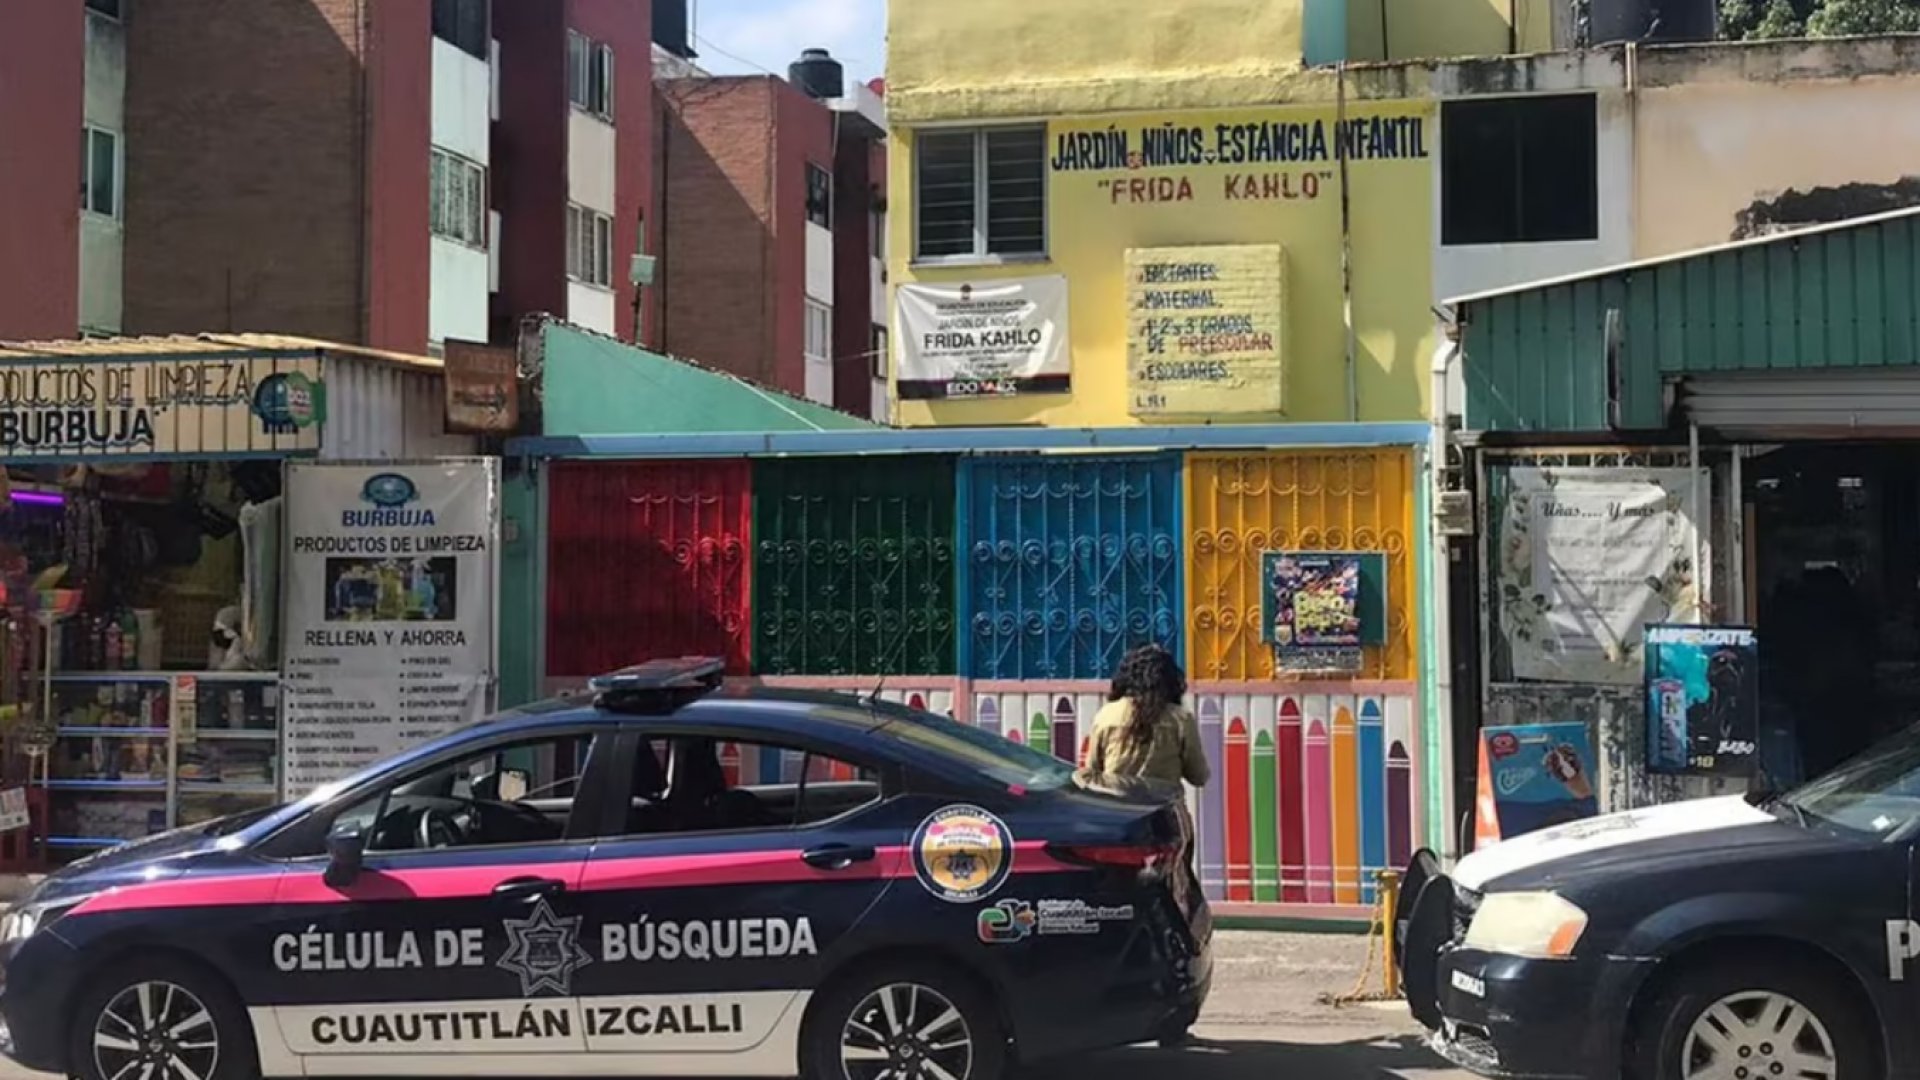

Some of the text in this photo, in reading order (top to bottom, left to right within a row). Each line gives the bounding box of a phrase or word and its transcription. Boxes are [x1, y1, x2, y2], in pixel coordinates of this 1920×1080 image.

[1052, 126, 1128, 170] JARDÍN
[1142, 121, 1204, 166] NIÑOS
[1215, 118, 1328, 162] ESTANCIA
[1335, 115, 1429, 160] INFANTIL
[924, 328, 1041, 350] FRIDA KAHLO
[106, 367, 134, 405] DE
[145, 364, 250, 404] LIMPIEZA
[342, 509, 435, 528] BURBUJA
[294, 535, 486, 552] PRODUCTOS DE LIMPIEZA
[305, 629, 466, 647] RELLENA Y AHORRA
[273, 914, 818, 972] CÉLULA DE BÚSQUEDA
[311, 1003, 743, 1044] CUAUTITLÁN IZCALLI
